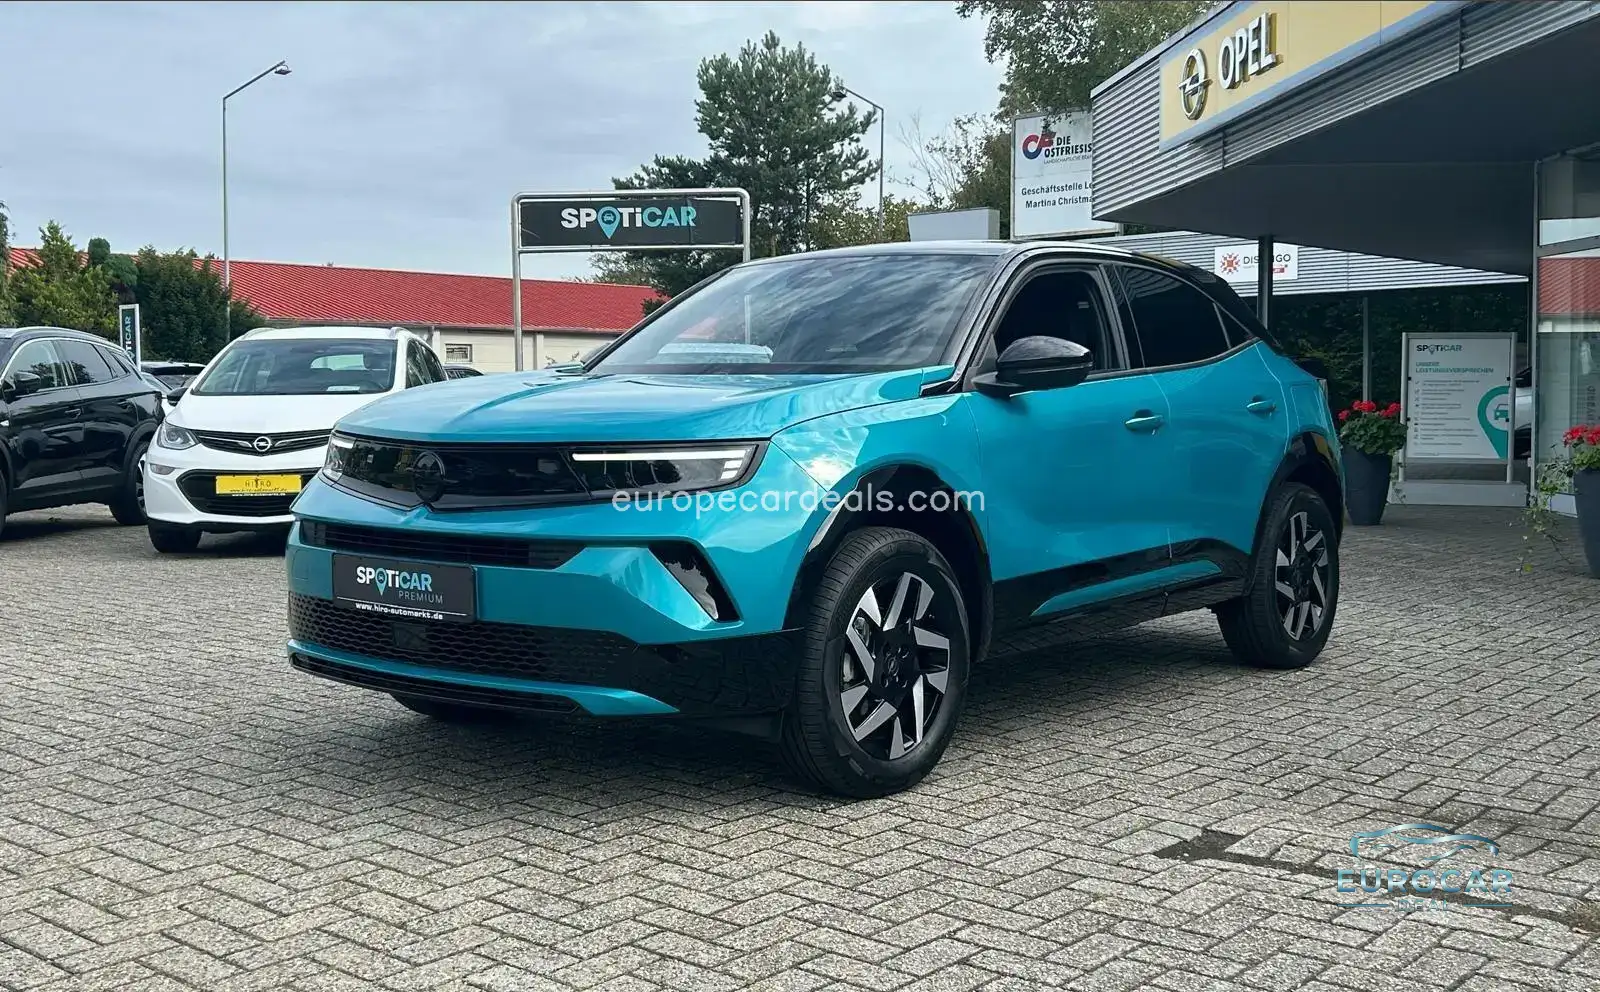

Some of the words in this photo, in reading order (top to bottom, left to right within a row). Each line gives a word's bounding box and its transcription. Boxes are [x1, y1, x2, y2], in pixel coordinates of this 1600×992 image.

[1218, 12, 1276, 89] OPEL
[1056, 136, 1071, 146] DIE
[1044, 143, 1092, 158] OSTFRIESIS
[1025, 199, 1056, 208] Martina
[1058, 196, 1093, 206] Christma
[1243, 253, 1291, 264] DISGO
[398, 590, 443, 605] PREMIUM
[355, 602, 443, 620] www.hiro-automarkt.de
